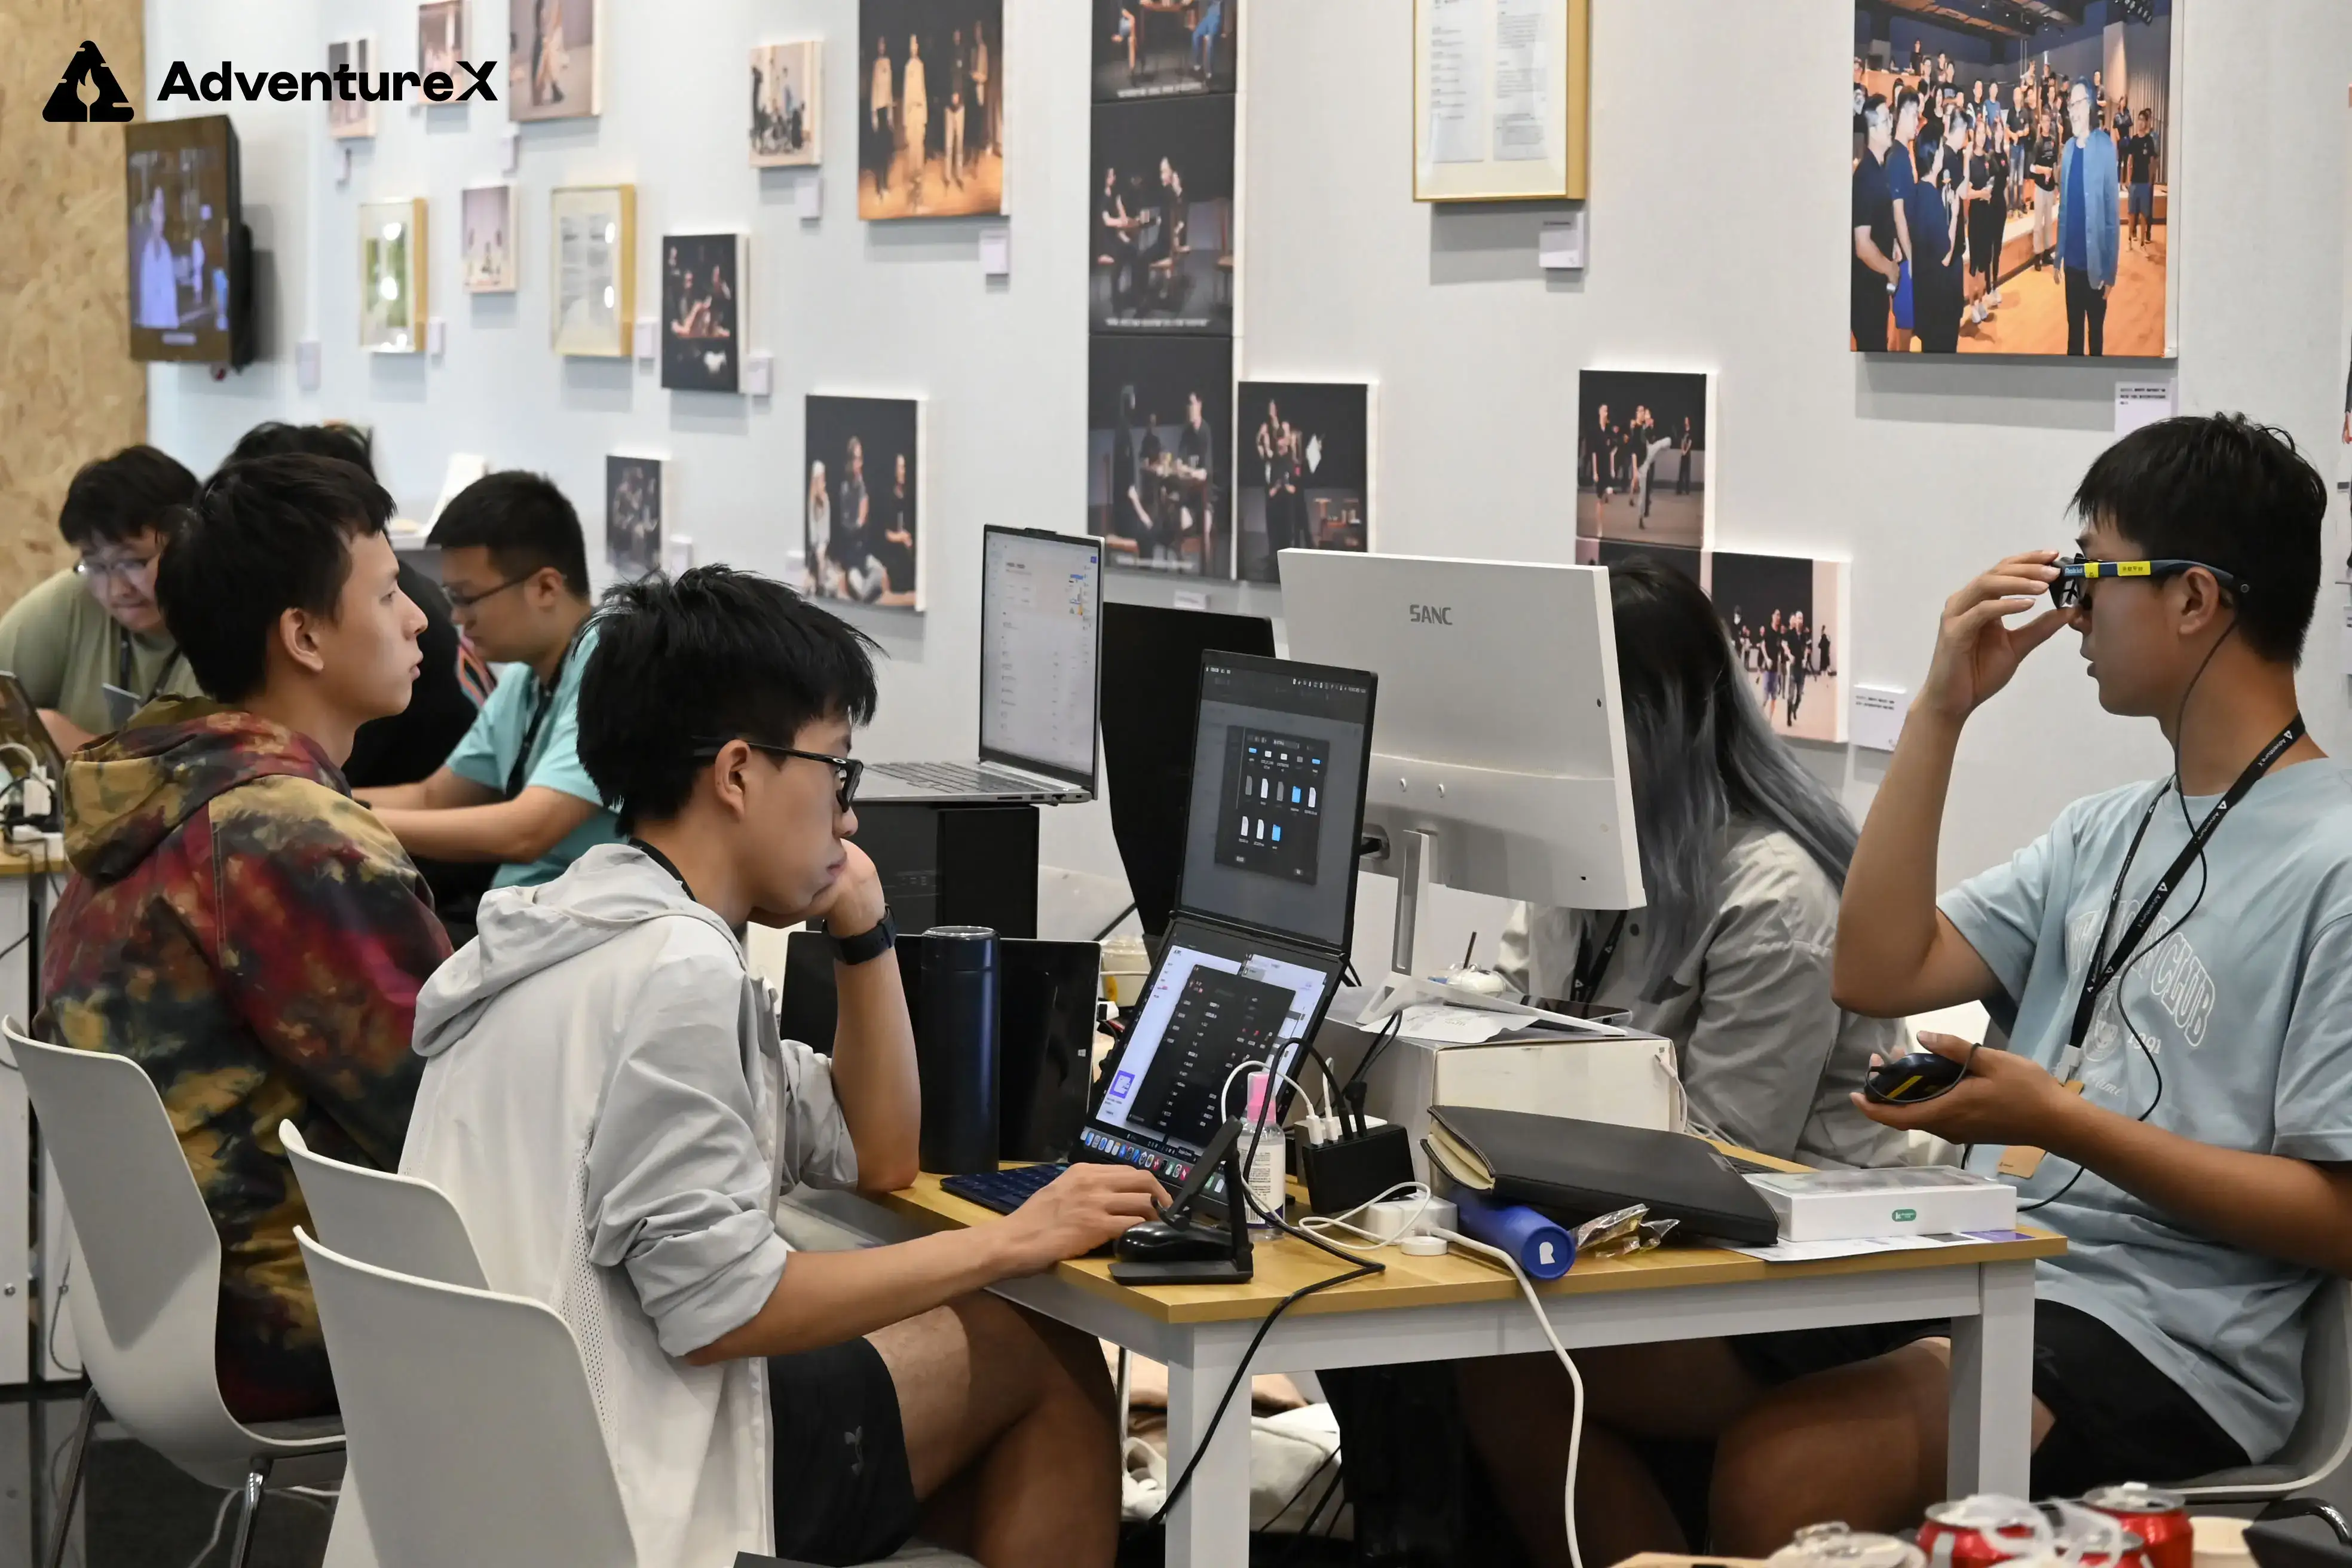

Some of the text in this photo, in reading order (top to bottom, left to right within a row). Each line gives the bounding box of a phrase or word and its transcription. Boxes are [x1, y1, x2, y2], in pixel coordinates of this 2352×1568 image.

[1410, 604, 1453, 626] SANC
[2151, 932, 2215, 1047] CLUB
[2127, 1032, 2162, 1054] 1991
